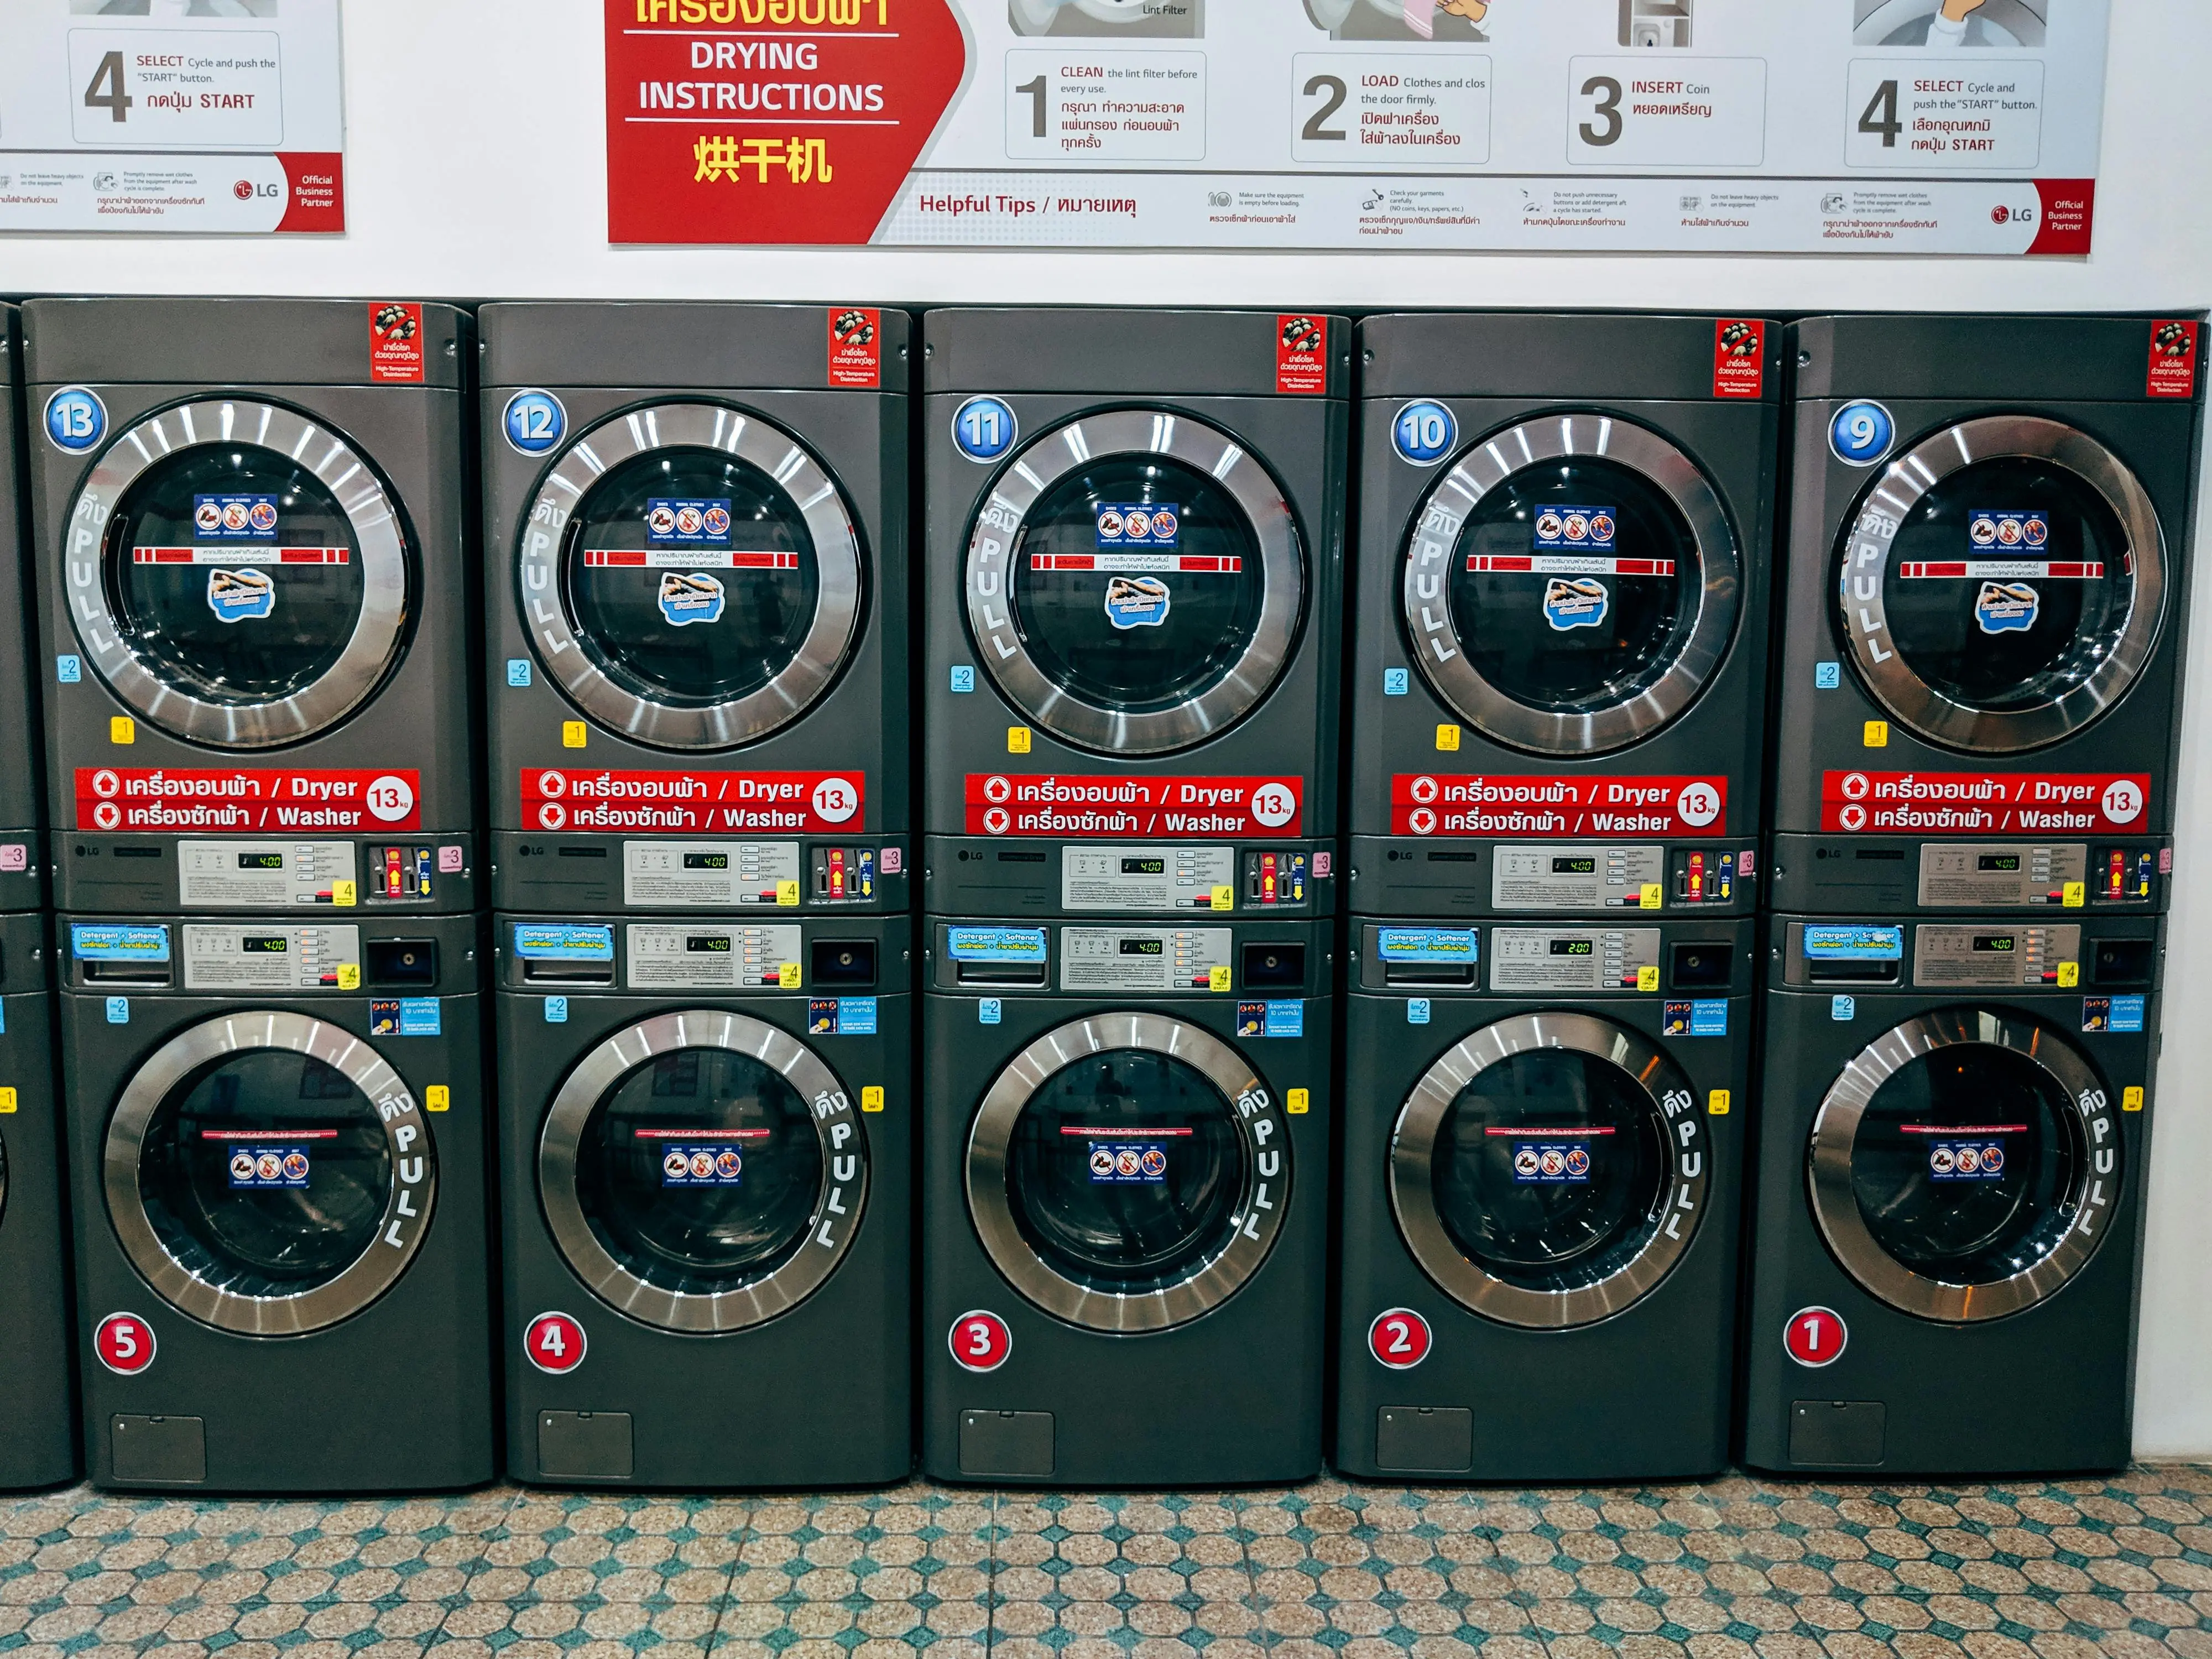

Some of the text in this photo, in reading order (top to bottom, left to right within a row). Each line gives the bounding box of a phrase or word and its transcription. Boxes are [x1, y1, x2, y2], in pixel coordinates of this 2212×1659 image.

[1143, 4, 1187, 15] Lint Filter
[137, 55, 276, 70] SELECT Cycle and push the
[691, 41, 817, 70] DRYING
[180, 73, 214, 83] button.
[1061, 66, 1197, 79] CLEAN the lint filter before
[1362, 75, 1485, 88] LOAD Clothes and clos
[84, 51, 133, 122] 4
[640, 82, 884, 111] INSTRUCTIONS
[1061, 86, 1086, 95] every
[1632, 81, 1710, 94] INSERT Coin
[1914, 80, 2015, 95] SELECT Cycle and
[148, 91, 255, 113] กดปุ่ม START
[1015, 75, 1047, 138] 1
[1062, 100, 1185, 116] กรุณา ทำความสะอาด
[1301, 75, 1347, 140] 2
[1361, 93, 1436, 107] the door firmly.
[1579, 76, 1623, 147] 3
[1633, 102, 1712, 118] หยอดเหรียญ
[1913, 99, 1937, 111] push
[1940, 99, 1956, 109] the
[2001, 100, 2038, 109] button.
[1062, 118, 1179, 131] แผ่นกรอง ก่อนอบผ้า
[1361, 109, 1439, 125] เปิดฝาเครื่อง
[1858, 80, 1903, 148] 4
[1061, 133, 1102, 152] ทุกครั้ง
[1360, 128, 1460, 145] ใส่ผ้าลงในเครื่อง
[1911, 137, 1995, 154] กดปุ่ม START
[693, 135, 833, 184] 烘干机
[257, 184, 278, 197] LG
[295, 186, 333, 196] Business
[302, 175, 333, 185] Official
[301, 198, 333, 207] Partner
[920, 195, 990, 217] Helpful
[995, 196, 1036, 217] Tips
[1058, 199, 1136, 218] หมายเหตุ
[2055, 200, 2084, 209] Official
[2012, 208, 2032, 222] LG
[2048, 211, 2083, 220] Business
[2052, 222, 2082, 231] Partner
[53, 401, 93, 437] 13
[513, 403, 554, 439] 12
[964, 410, 1001, 445] 11
[1402, 413, 1447, 449] 10
[1848, 414, 1876, 450] 9
[70, 526, 114, 655] PULL
[527, 532, 568, 654] PULL
[977, 538, 1016, 659] PULL
[1417, 541, 1457, 662] PULL
[1853, 544, 1893, 664] PULL
[126, 770, 358, 800] เครื่องอบผ้า Dryer
[572, 772, 804, 803] เครื่องอบผ้า Dryer
[1018, 777, 1244, 807] เครื่องอบผ้า Dryer
[1444, 777, 1671, 807] เครื่องอบผ้า Dryer
[1875, 774, 2095, 804] เครื่องอบผ้า Dryer
[369, 787, 400, 809] 13
[815, 789, 843, 809] 13
[1254, 794, 1282, 814] 13
[1680, 792, 1707, 814] 13
[2104, 789, 2130, 811] 13
[128, 801, 362, 826] เครื่องซักผ้า Washer
[574, 801, 806, 827] เครื่องซักผ้า Washer
[1018, 809, 1245, 831] เครื่องซักผ้า Washer
[1444, 806, 1671, 831] เครื่องซักผ้า Washer
[1874, 803, 2095, 828] เครื่องซักผ้า Washer
[80, 931, 161, 940] Detergent Softener
[523, 929, 606, 940] Detergent Softener
[956, 931, 1039, 942] Detergent Softener
[1387, 933, 1470, 943] Detergent Softener
[377, 1092, 424, 1249] ดึง PULL
[815, 1088, 856, 1248] ดึง PULL
[1237, 1088, 1280, 1240] ดึง PULL
[1663, 1087, 1701, 1240] ดึง PULL
[2077, 1087, 2115, 1237] ดึง PULL
[114, 1324, 138, 1359] 5
[541, 1323, 565, 1358] 4
[969, 1321, 992, 1355] 3
[1386, 1321, 1411, 1353] 2
[1801, 1318, 1822, 1350] 1
